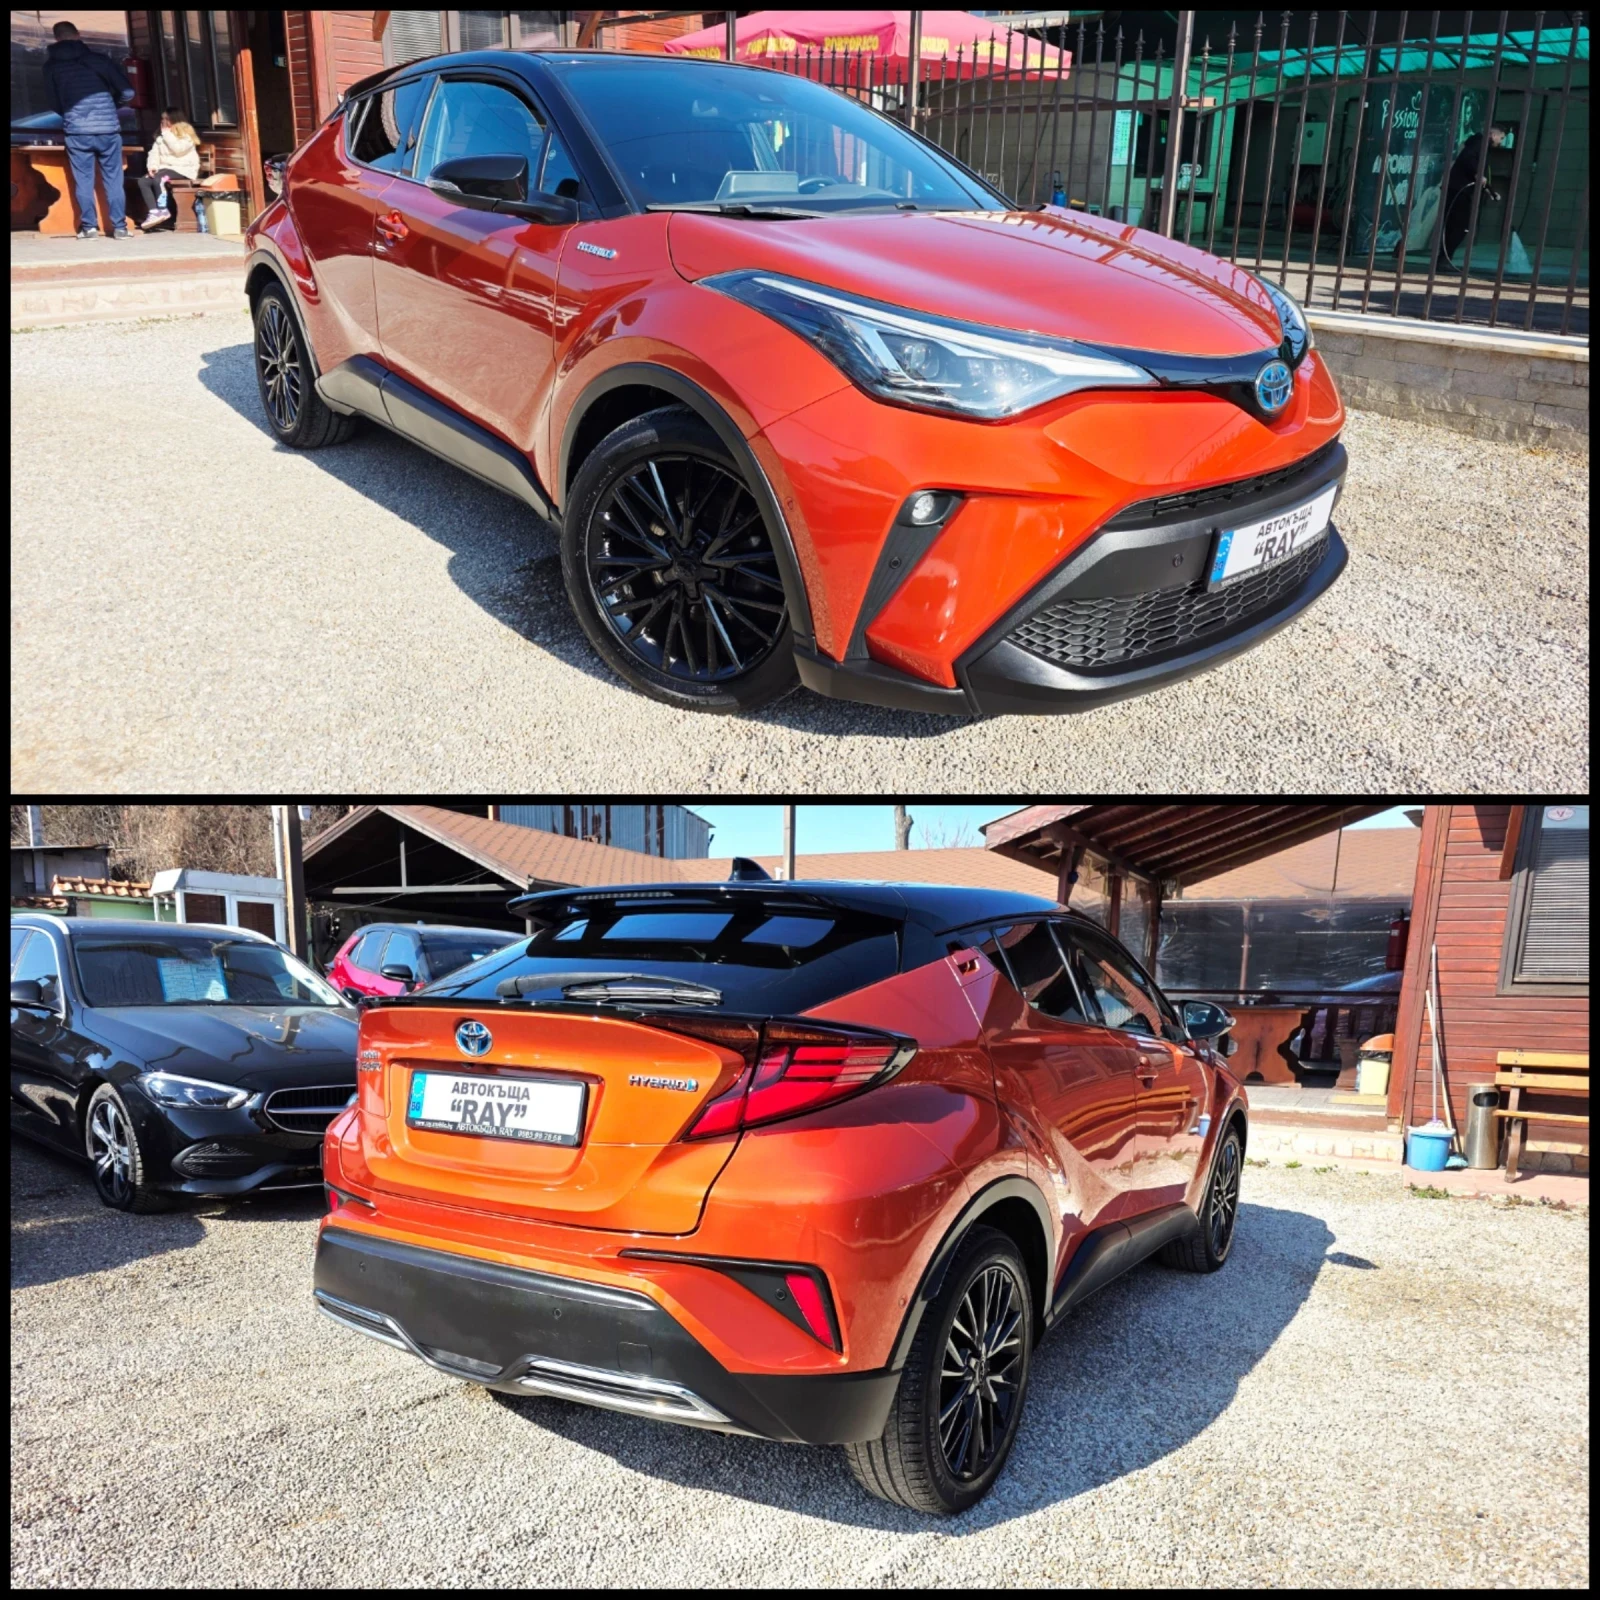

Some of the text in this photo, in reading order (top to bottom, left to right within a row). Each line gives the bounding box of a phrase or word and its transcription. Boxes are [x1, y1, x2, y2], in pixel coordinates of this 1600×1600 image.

[823, 34, 879, 51] PORTORICO
[1256, 505, 1313, 539] АВТОКЪЩА
[629, 1074, 688, 1091] HYBRID
[451, 1082, 531, 1102] АВТОКЪЩА
[411, 1101, 421, 1112] BG
[456, 1122, 497, 1135] АВТОКЪЩА
[499, 1126, 515, 1137] RAY
